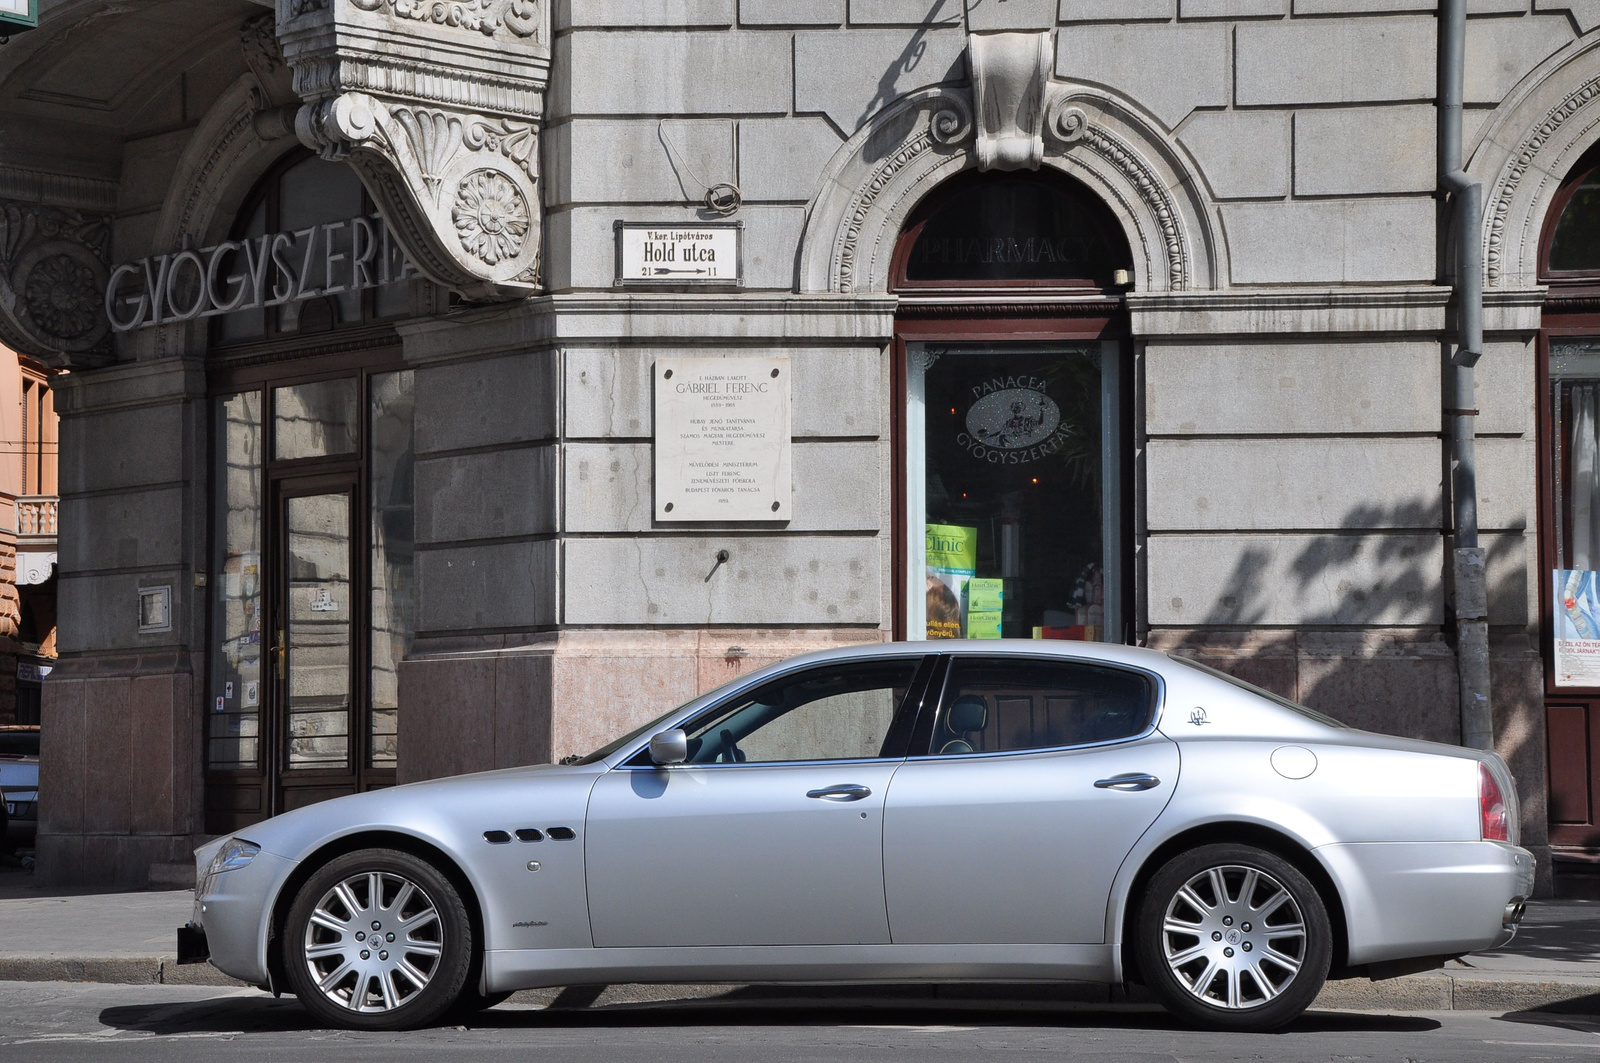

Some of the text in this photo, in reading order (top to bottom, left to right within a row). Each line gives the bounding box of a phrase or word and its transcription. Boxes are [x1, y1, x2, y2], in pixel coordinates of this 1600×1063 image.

[670, 231, 713, 242] Lipótváros
[644, 242, 715, 262] Hold utca
[921, 237, 1095, 264] PHARMACY
[641, 267, 651, 276] 21
[708, 267, 717, 276] 11
[676, 382, 768, 394] GÁBRIEL FERENC
[972, 375, 1047, 399] PANACEA
[956, 421, 1075, 464] GYÓGYSZERTÁR
